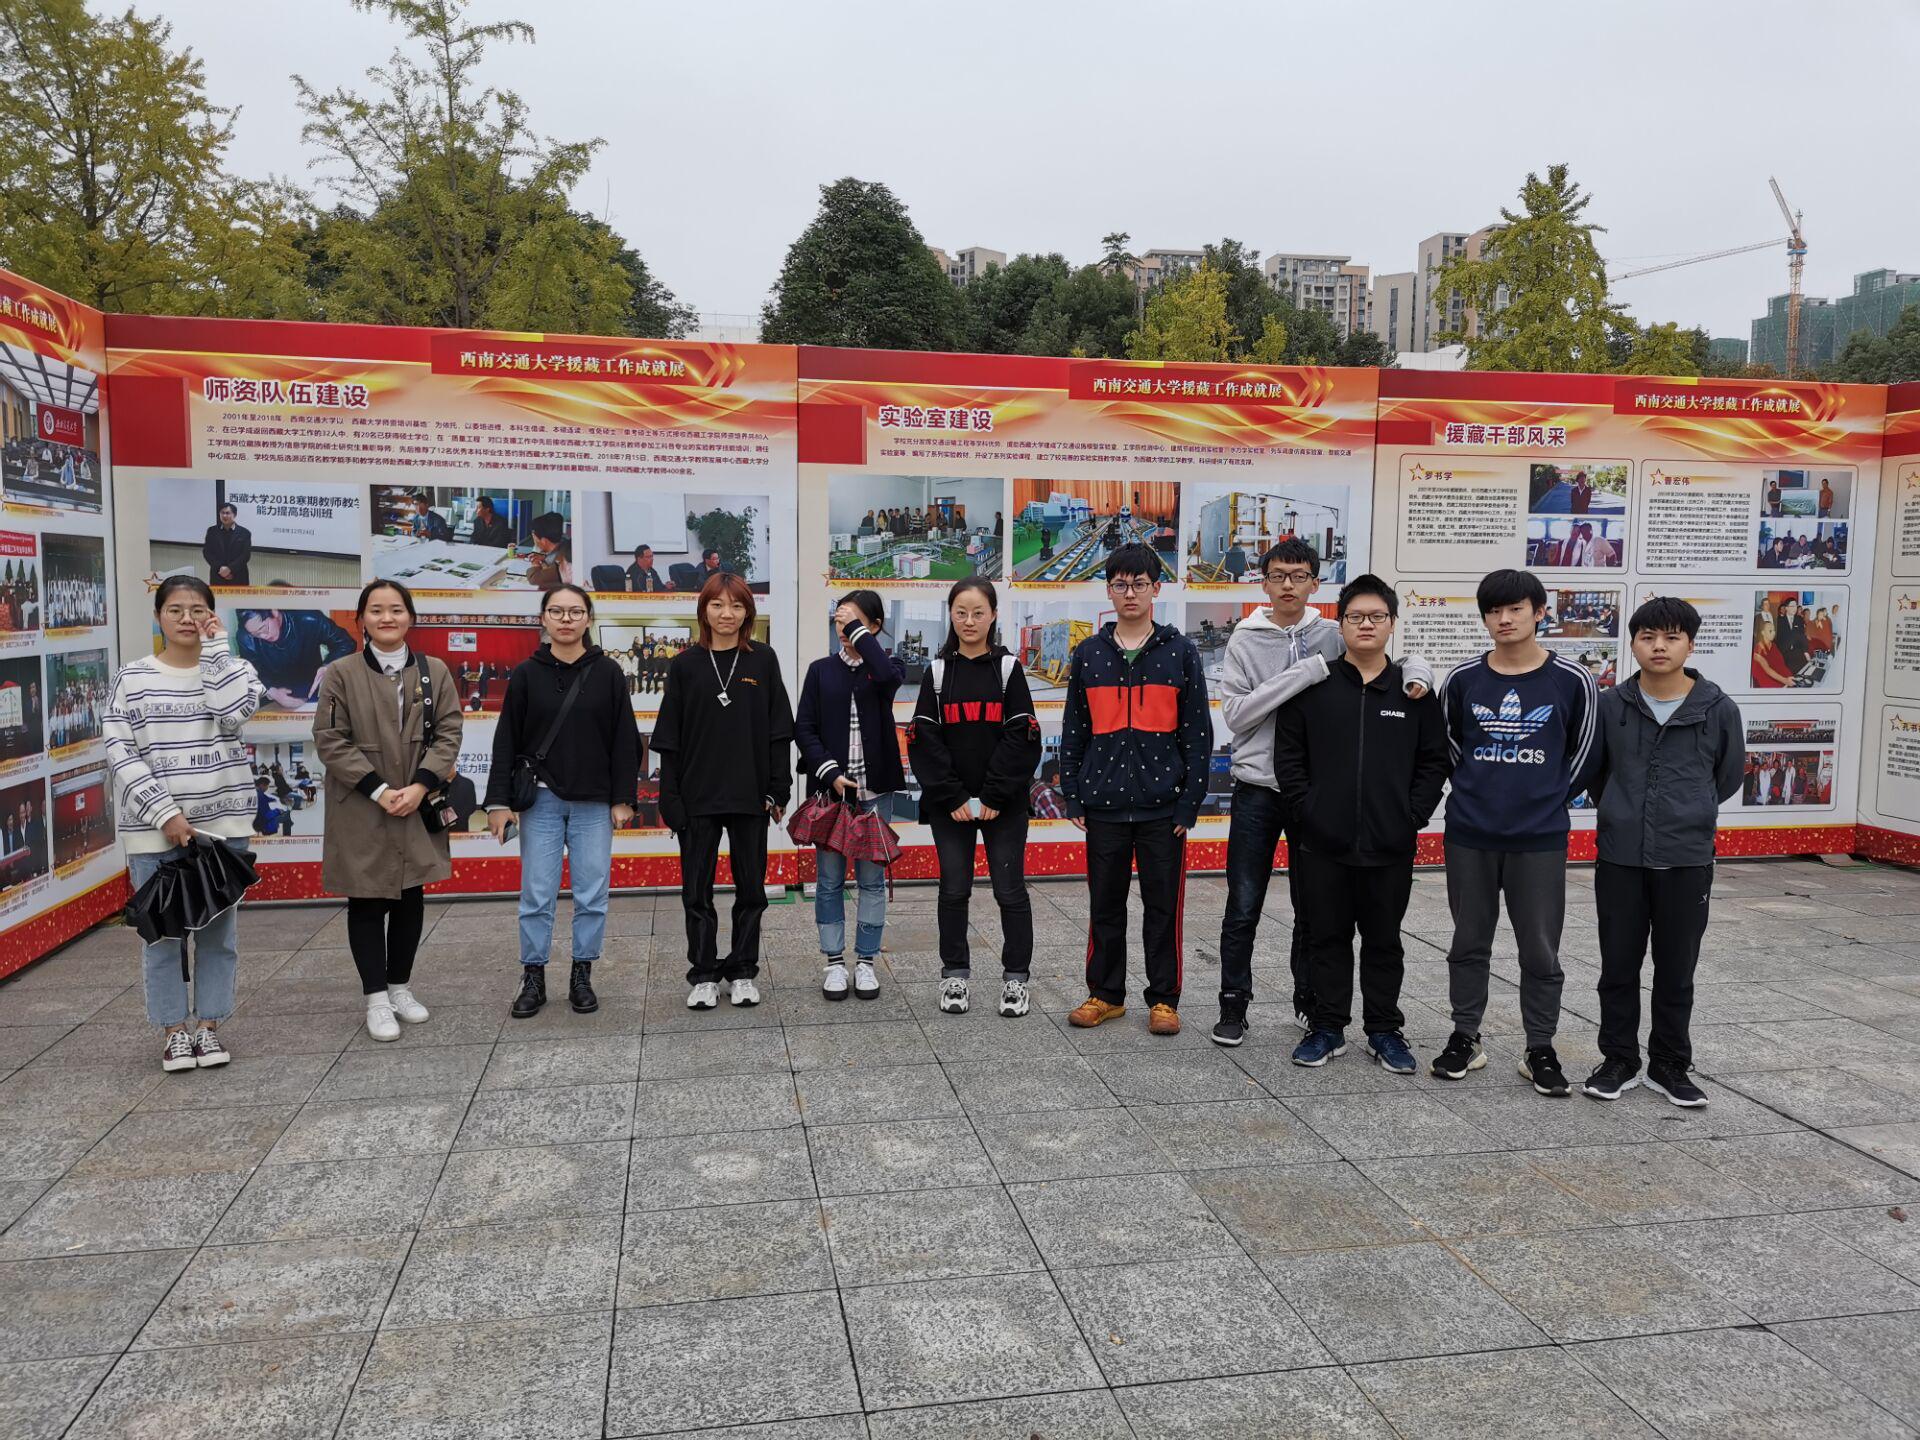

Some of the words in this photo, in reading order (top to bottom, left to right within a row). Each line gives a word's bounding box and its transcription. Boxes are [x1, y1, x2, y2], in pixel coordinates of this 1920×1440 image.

[0, 295, 57, 333] 藏工作成就展
[460, 351, 686, 377] 西南交通大学援藏工作成就展
[205, 378, 369, 408] 师资队伍建设
[1092, 377, 1283, 399] 西南交通大学援藏工作成就展
[1635, 393, 1801, 413] 西南交通大学援藏工作成就展
[879, 406, 994, 432] 实验室建设
[1446, 423, 1566, 446] 援藏干部风采
[256, 505, 333, 519] 能力提高培训班
[1473, 743, 1546, 765] adidas
